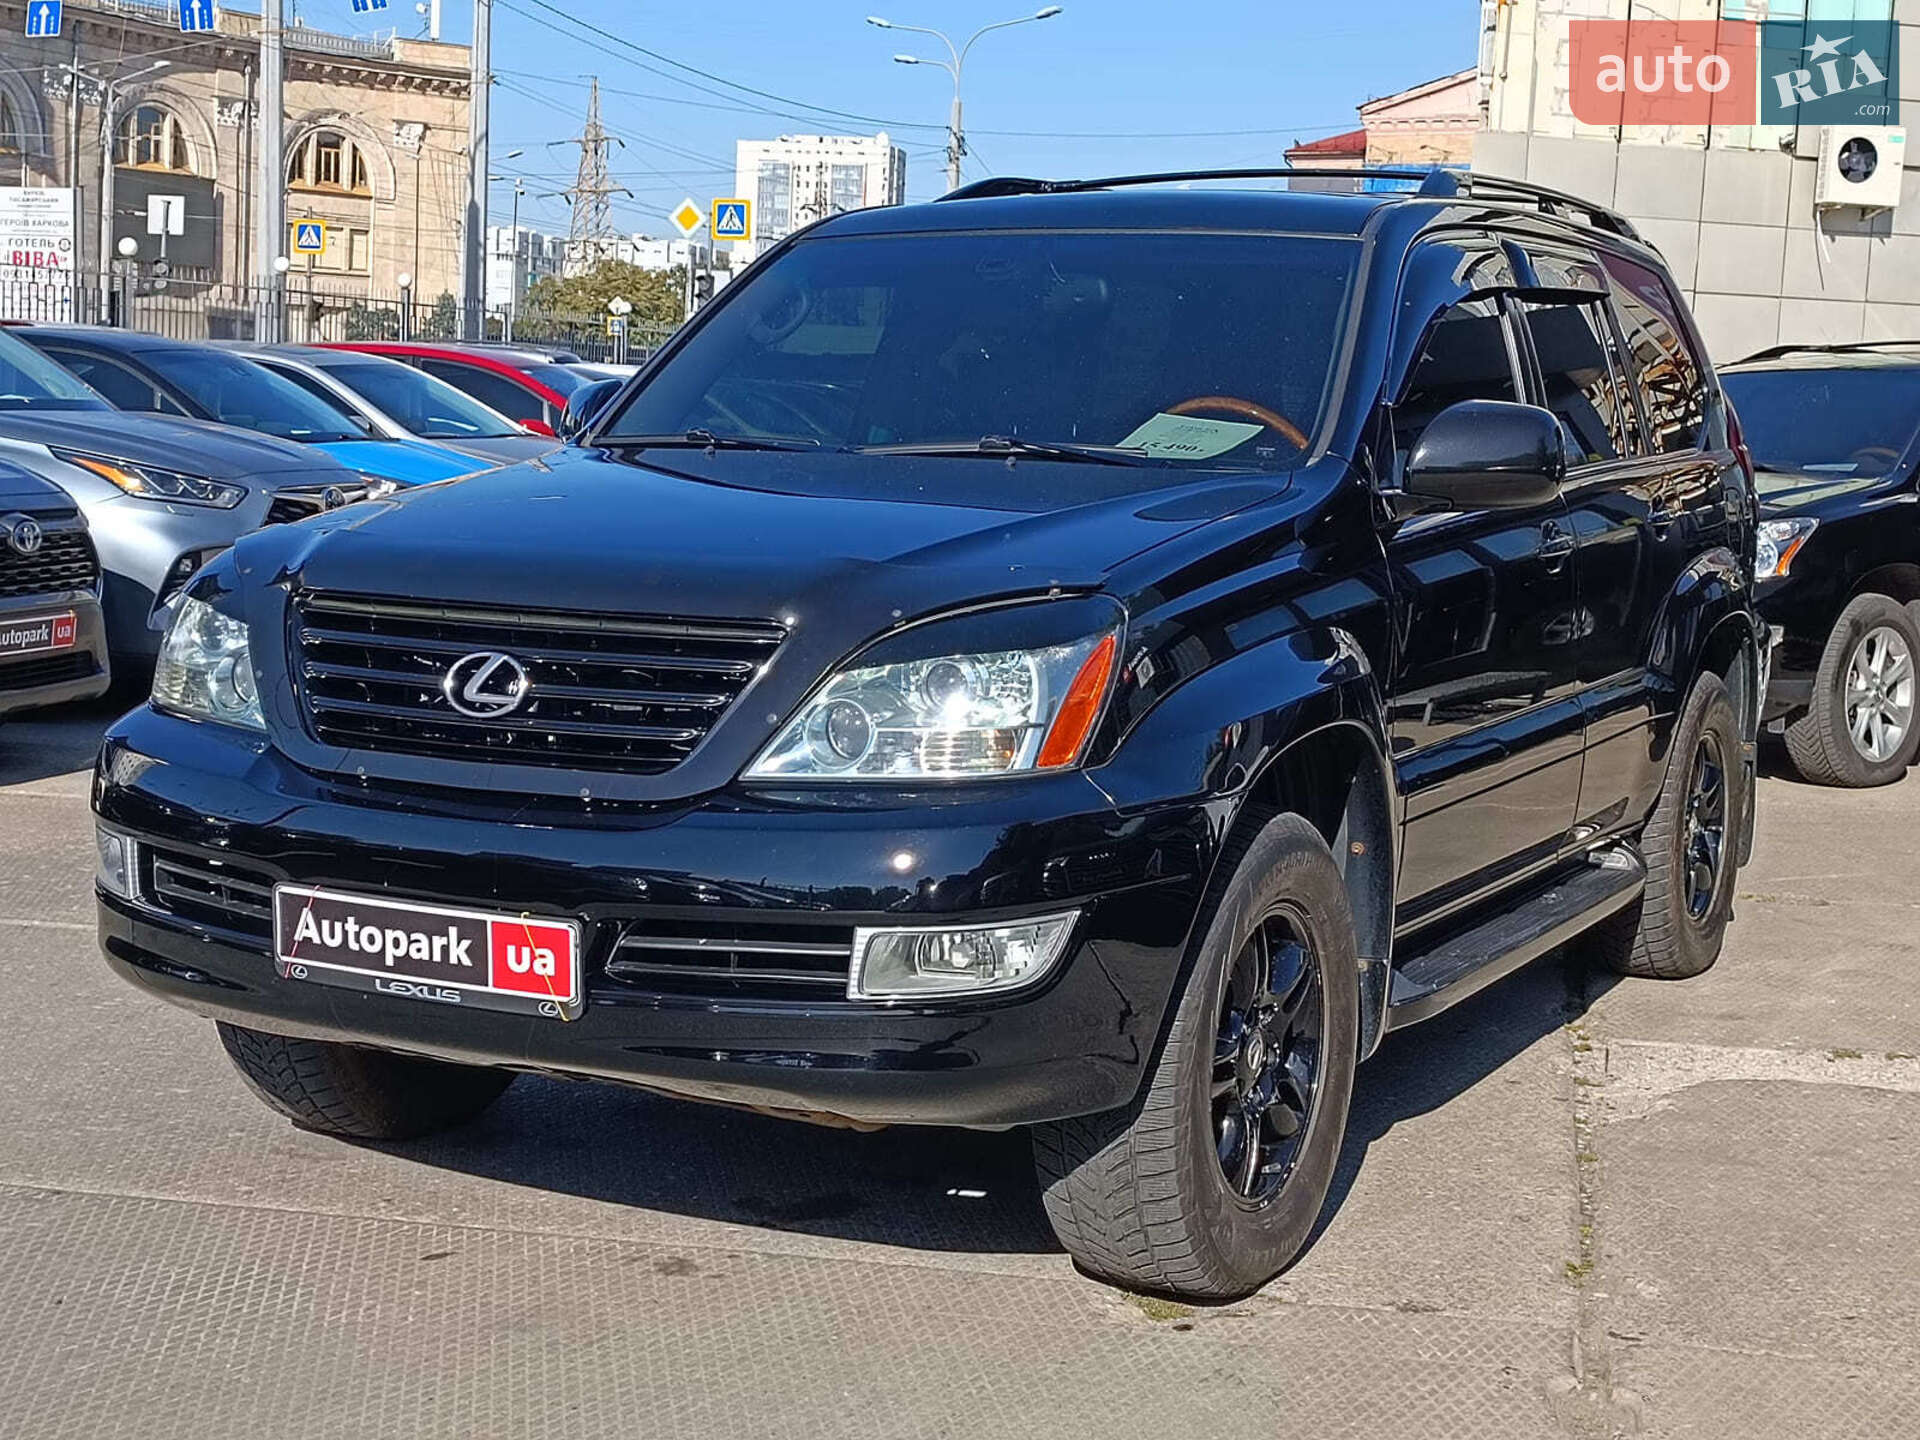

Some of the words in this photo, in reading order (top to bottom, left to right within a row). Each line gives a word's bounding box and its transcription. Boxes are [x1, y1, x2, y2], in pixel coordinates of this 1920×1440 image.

[8, 238, 55, 248] ГОТЕЛЬ
[0, 624, 49, 648] utopark
[57, 625, 71, 638] ua
[294, 907, 473, 967] Autopark
[506, 944, 555, 977] ua
[375, 978, 461, 1003] LEXUS
